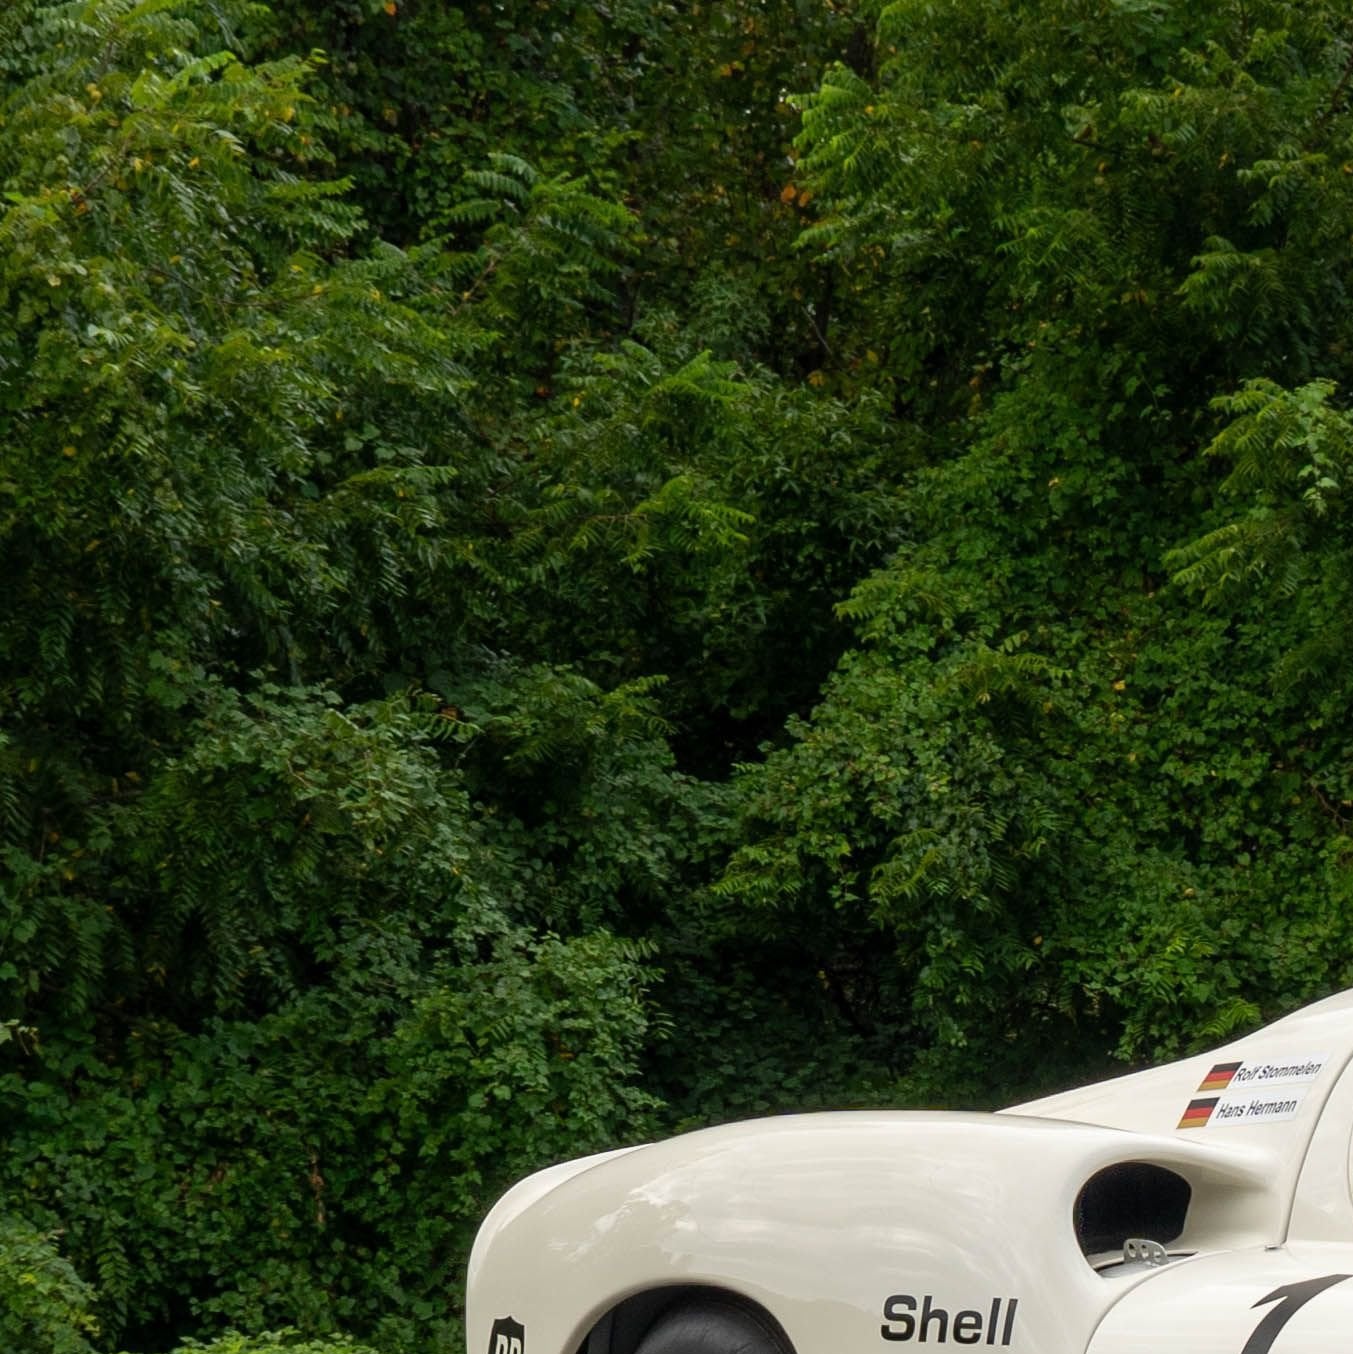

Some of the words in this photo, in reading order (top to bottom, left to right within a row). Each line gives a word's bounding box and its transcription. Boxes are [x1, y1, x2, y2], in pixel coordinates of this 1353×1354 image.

[1233, 1065, 1259, 1082] Rolf
[1216, 1102, 1245, 1119] Hans
[1247, 1100, 1297, 1116] Hermann
[881, 1294, 1018, 1346] Shell
